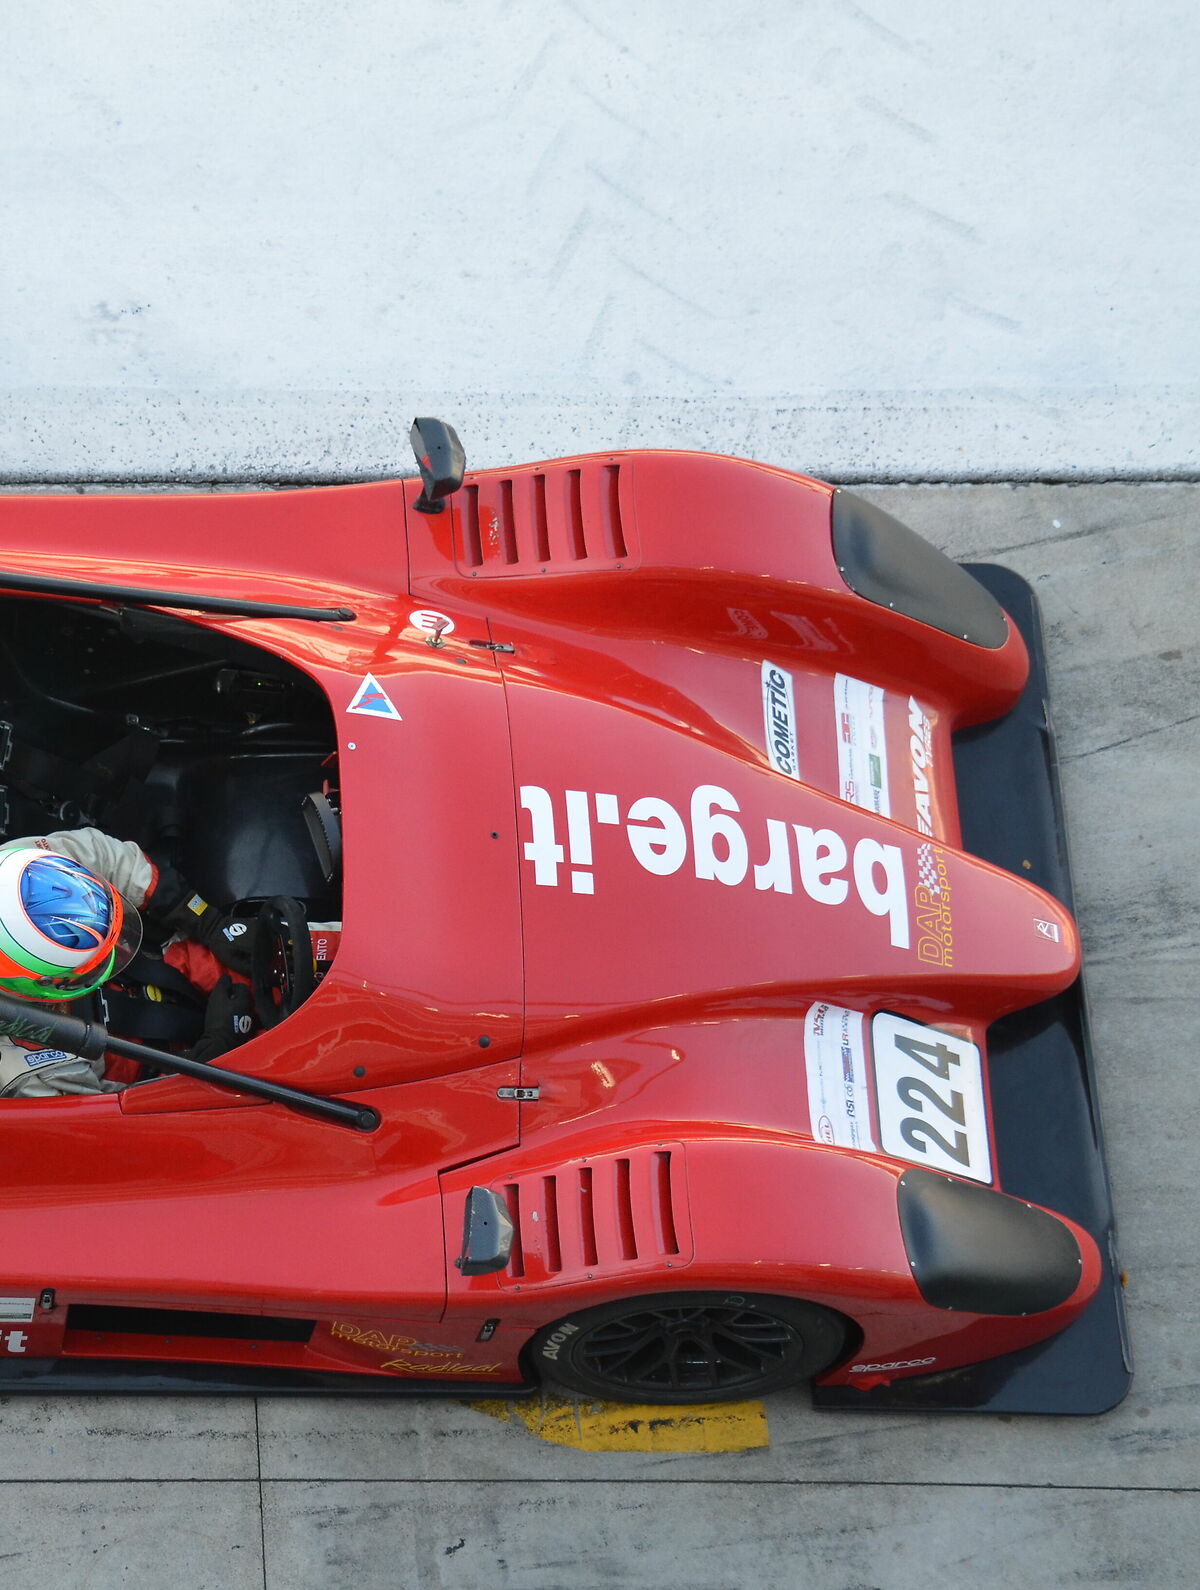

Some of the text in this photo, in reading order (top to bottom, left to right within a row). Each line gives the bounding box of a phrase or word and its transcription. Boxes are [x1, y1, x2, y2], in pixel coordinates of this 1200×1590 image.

[768, 669, 791, 774] COMETIC
[909, 696, 931, 829] AVON
[520, 784, 910, 949] barge.it
[934, 848, 953, 967] motorsport
[915, 884, 944, 966] DAP
[27, 1050, 65, 1066] sparco
[894, 1034, 970, 1168] 224
[331, 1328, 465, 1359] motorsport
[332, 1320, 417, 1348] DAP
[543, 1323, 580, 1361] AVON
[849, 1356, 937, 1373] sparco
